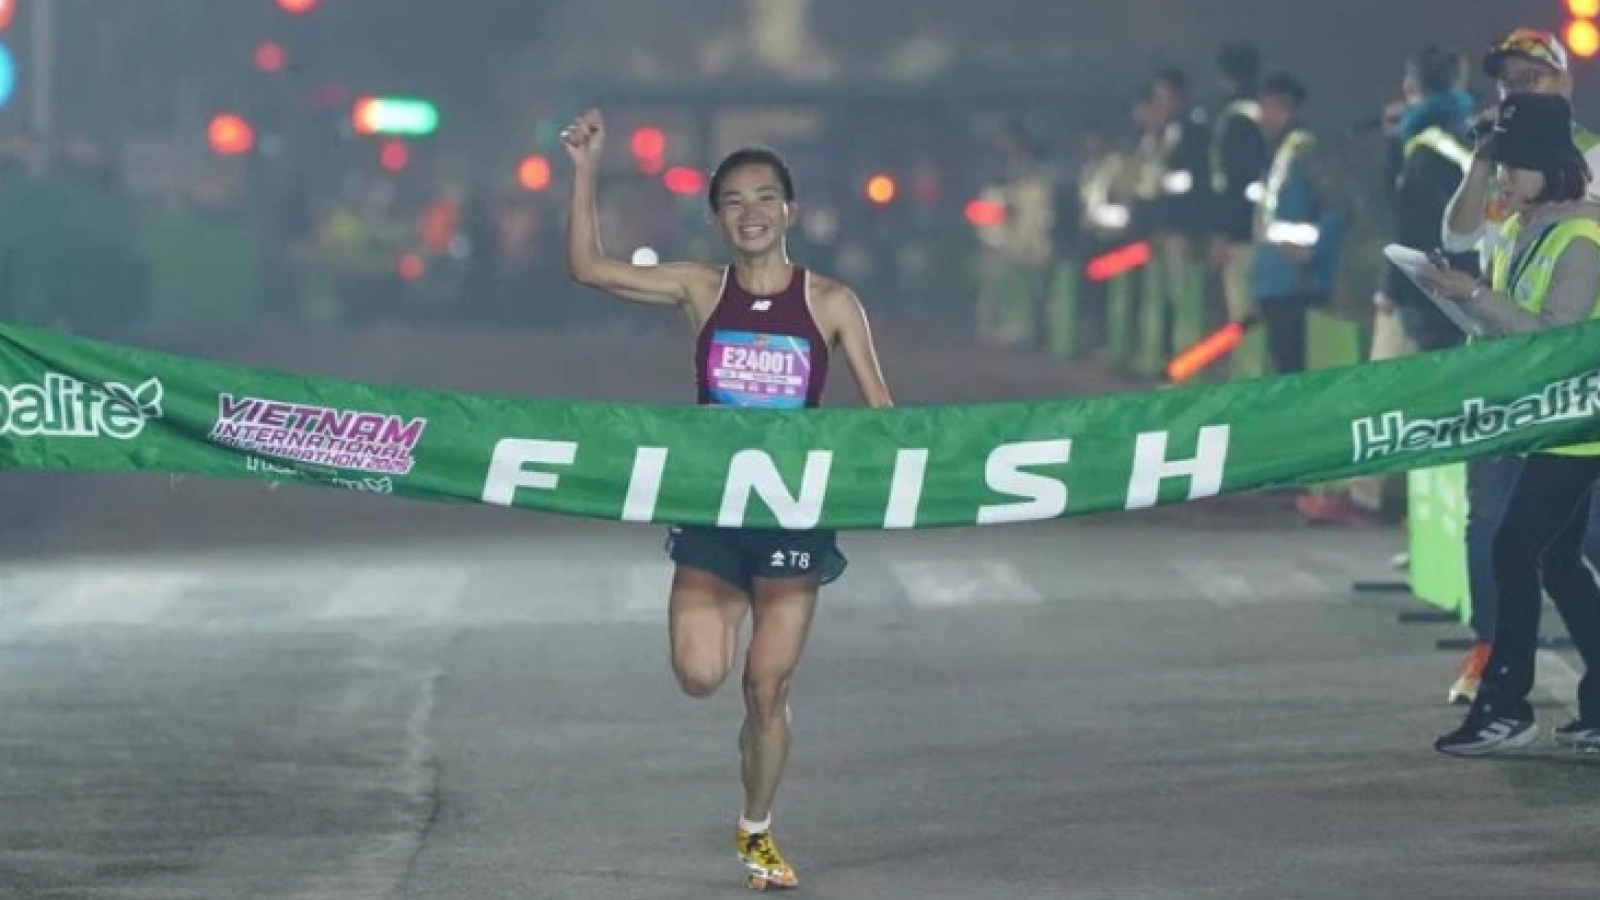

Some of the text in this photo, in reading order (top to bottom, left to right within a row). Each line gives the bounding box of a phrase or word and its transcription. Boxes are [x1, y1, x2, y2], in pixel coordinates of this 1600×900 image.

[721, 345, 795, 375] E24001
[214, 422, 409, 460] INTERNATIONAL
[219, 393, 427, 447] VIETNAM
[1352, 369, 1600, 462] Herbalif
[482, 424, 1230, 529] FINISH
